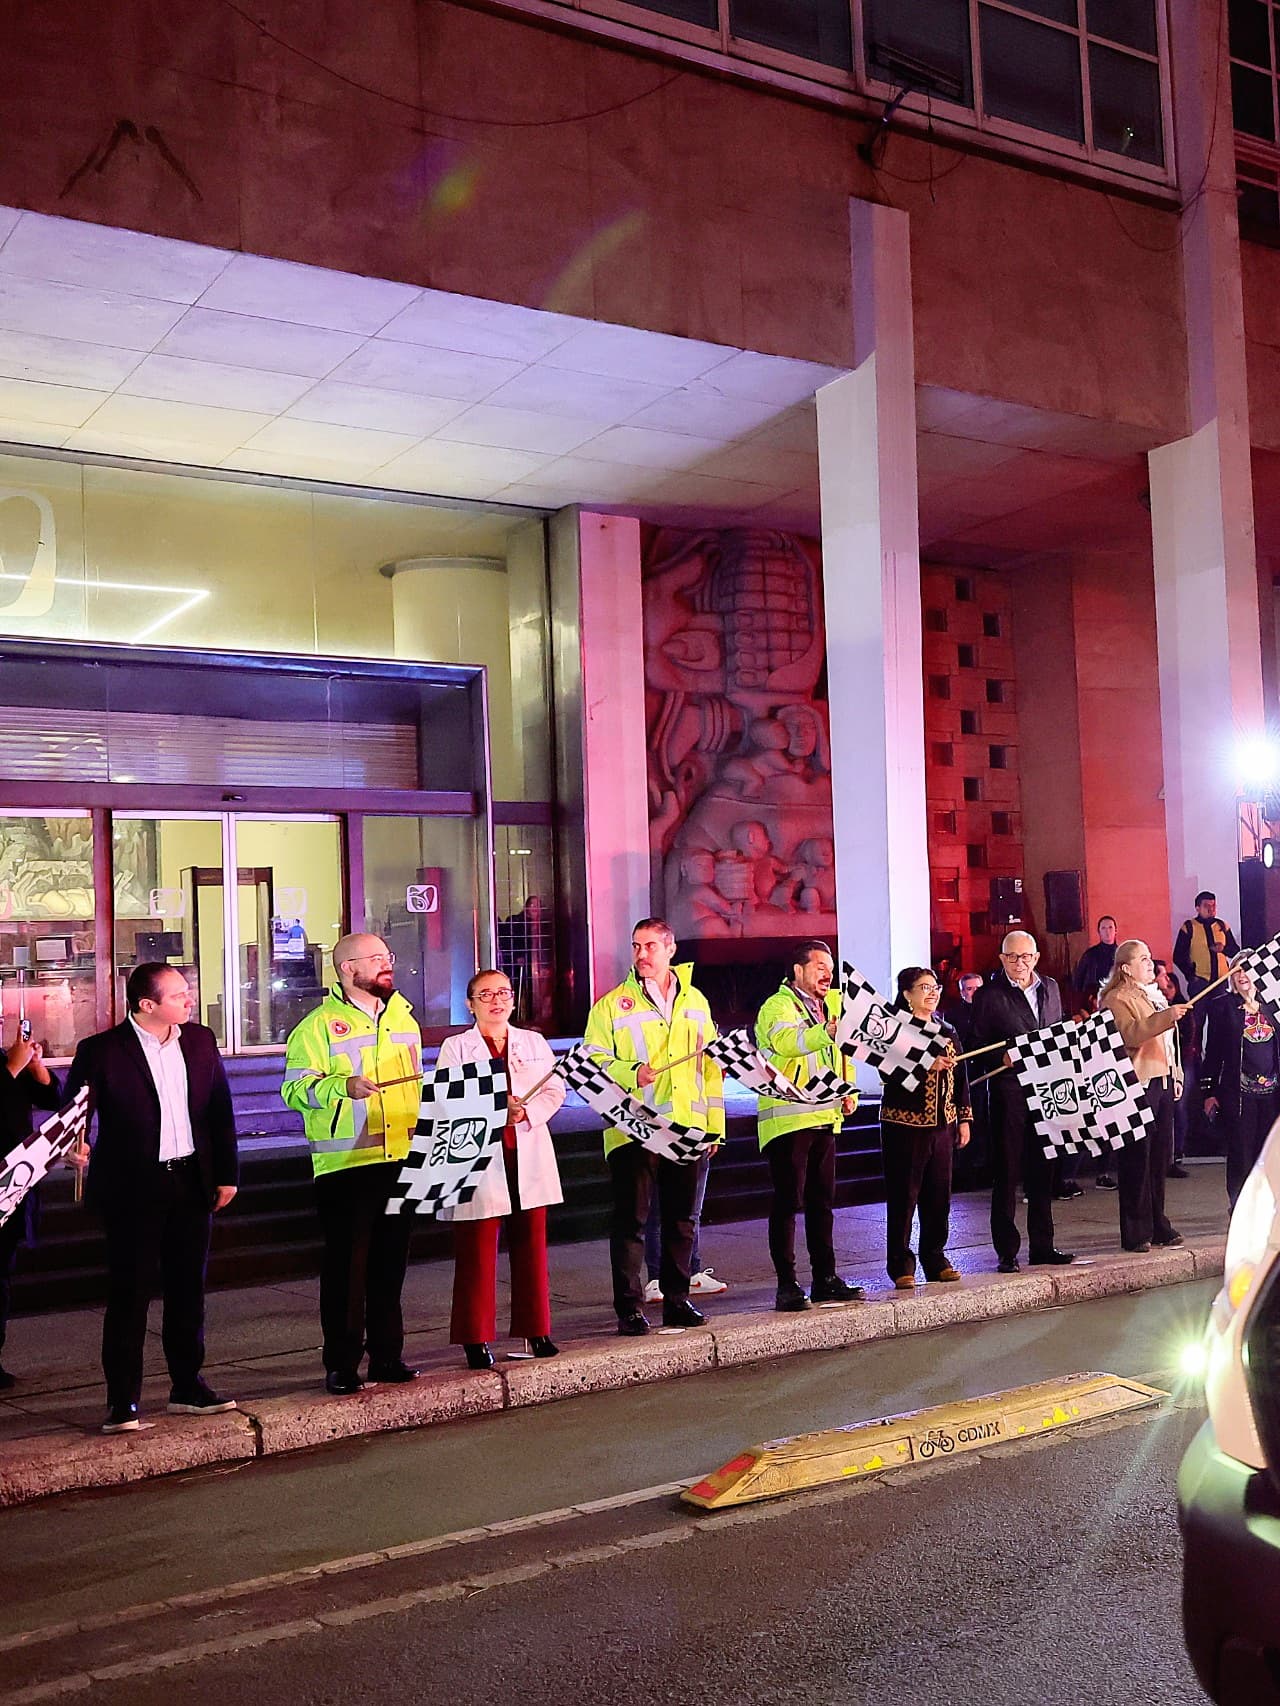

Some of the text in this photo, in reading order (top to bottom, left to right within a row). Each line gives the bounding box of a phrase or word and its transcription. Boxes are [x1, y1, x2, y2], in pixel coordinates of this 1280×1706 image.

[850, 1029, 890, 1053] IMSS
[1036, 1082, 1058, 1119] IMSS
[609, 1105, 654, 1139] IMSS
[429, 1120, 450, 1167] IMSS
[957, 1421, 1001, 1442] CDMX
